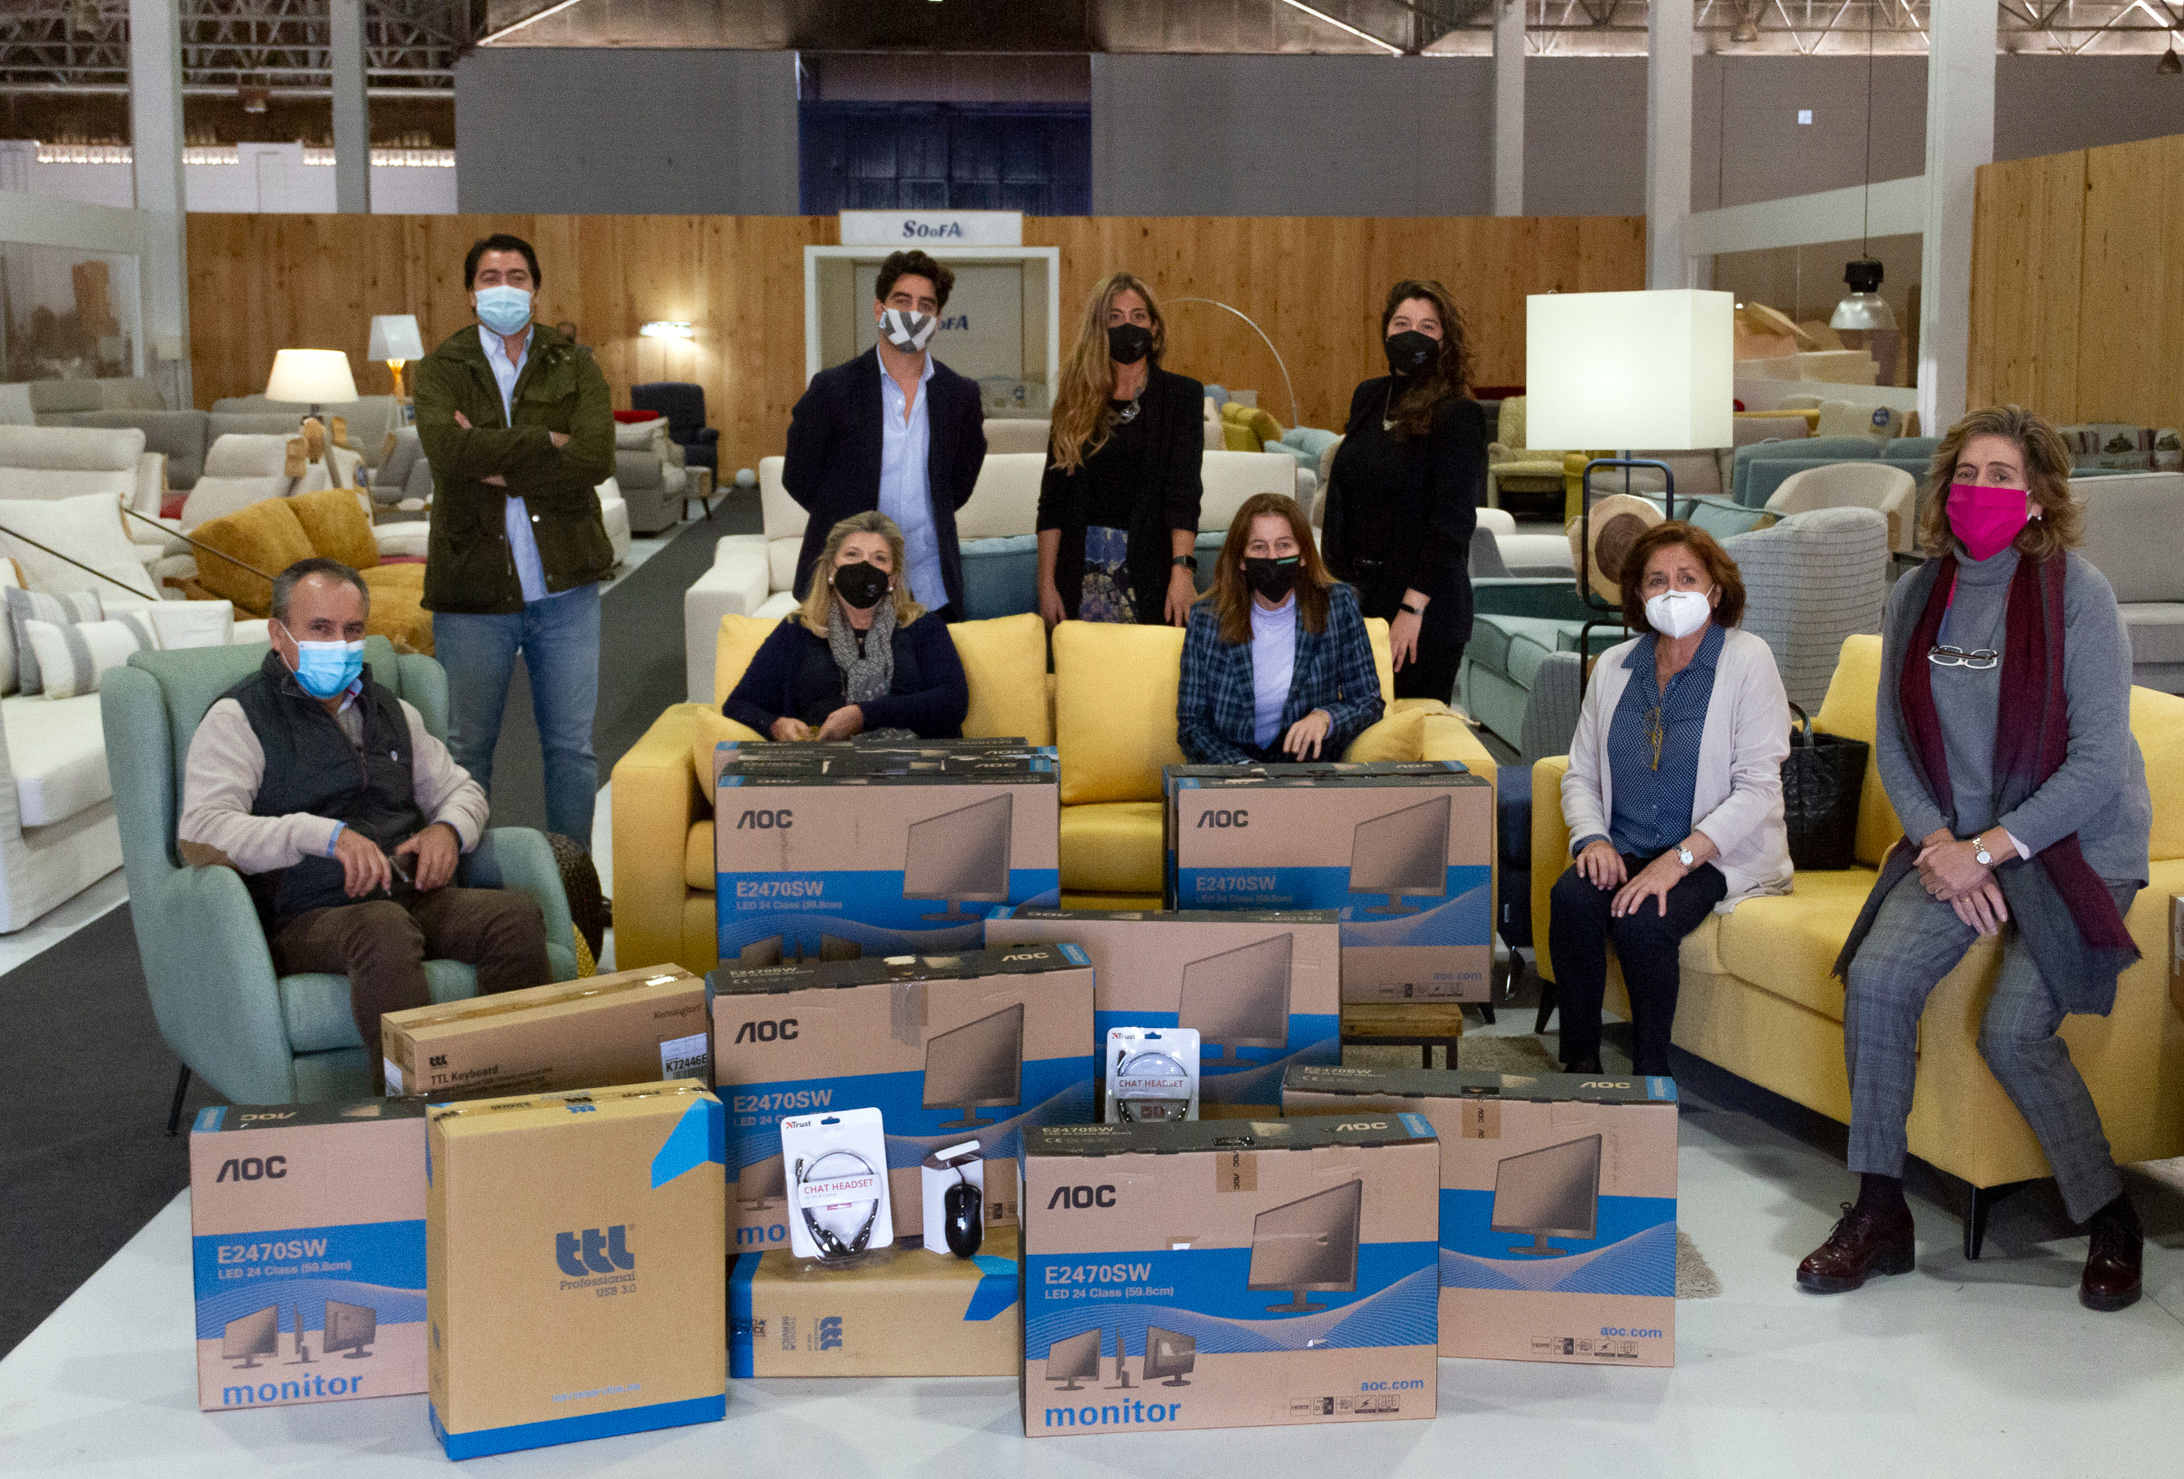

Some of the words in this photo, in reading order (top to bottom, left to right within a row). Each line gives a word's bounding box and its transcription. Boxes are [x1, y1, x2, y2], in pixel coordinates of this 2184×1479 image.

[737, 809, 793, 829] AOC
[1197, 809, 1249, 828] AOC
[736, 880, 824, 897] E2470SW
[1196, 876, 1276, 892] E2470SW
[1001, 951, 1050, 962] AOC
[734, 1018, 799, 1044] AOC
[431, 1075, 449, 1086] TTL
[451, 1064, 499, 1082] Keyboard
[1119, 1079, 1143, 1088] CHAT
[1579, 1081, 1632, 1089] AOC
[733, 1088, 832, 1112] E2470SW
[733, 1114, 757, 1127] LED
[759, 1113, 772, 1125] 24
[791, 1120, 812, 1129] Trust
[1335, 1121, 1389, 1132] AOC
[215, 1155, 287, 1183] AOC
[803, 1183, 830, 1195] CHAT
[832, 1178, 874, 1191] HEADSET
[1047, 1184, 1116, 1210] AOC
[217, 1238, 328, 1264] E2470SW
[556, 1224, 635, 1277] ttl
[218, 1267, 244, 1280] LED
[247, 1266, 261, 1278] 24
[264, 1264, 298, 1277] Class
[1045, 1263, 1152, 1285] E2470SW
[559, 1271, 636, 1291] Professional
[596, 1286, 618, 1298] USB
[621, 1284, 636, 1295] 3.0
[1045, 1288, 1069, 1300] LED
[1072, 1287, 1087, 1299] 24
[1089, 1286, 1122, 1298] Class
[1125, 1285, 1174, 1298] (59.8cm)
[1600, 1326, 1663, 1339] aoc.com
[222, 1372, 363, 1406] monitor
[1360, 1378, 1425, 1392] aoc.com
[1045, 1397, 1182, 1427] monitor
